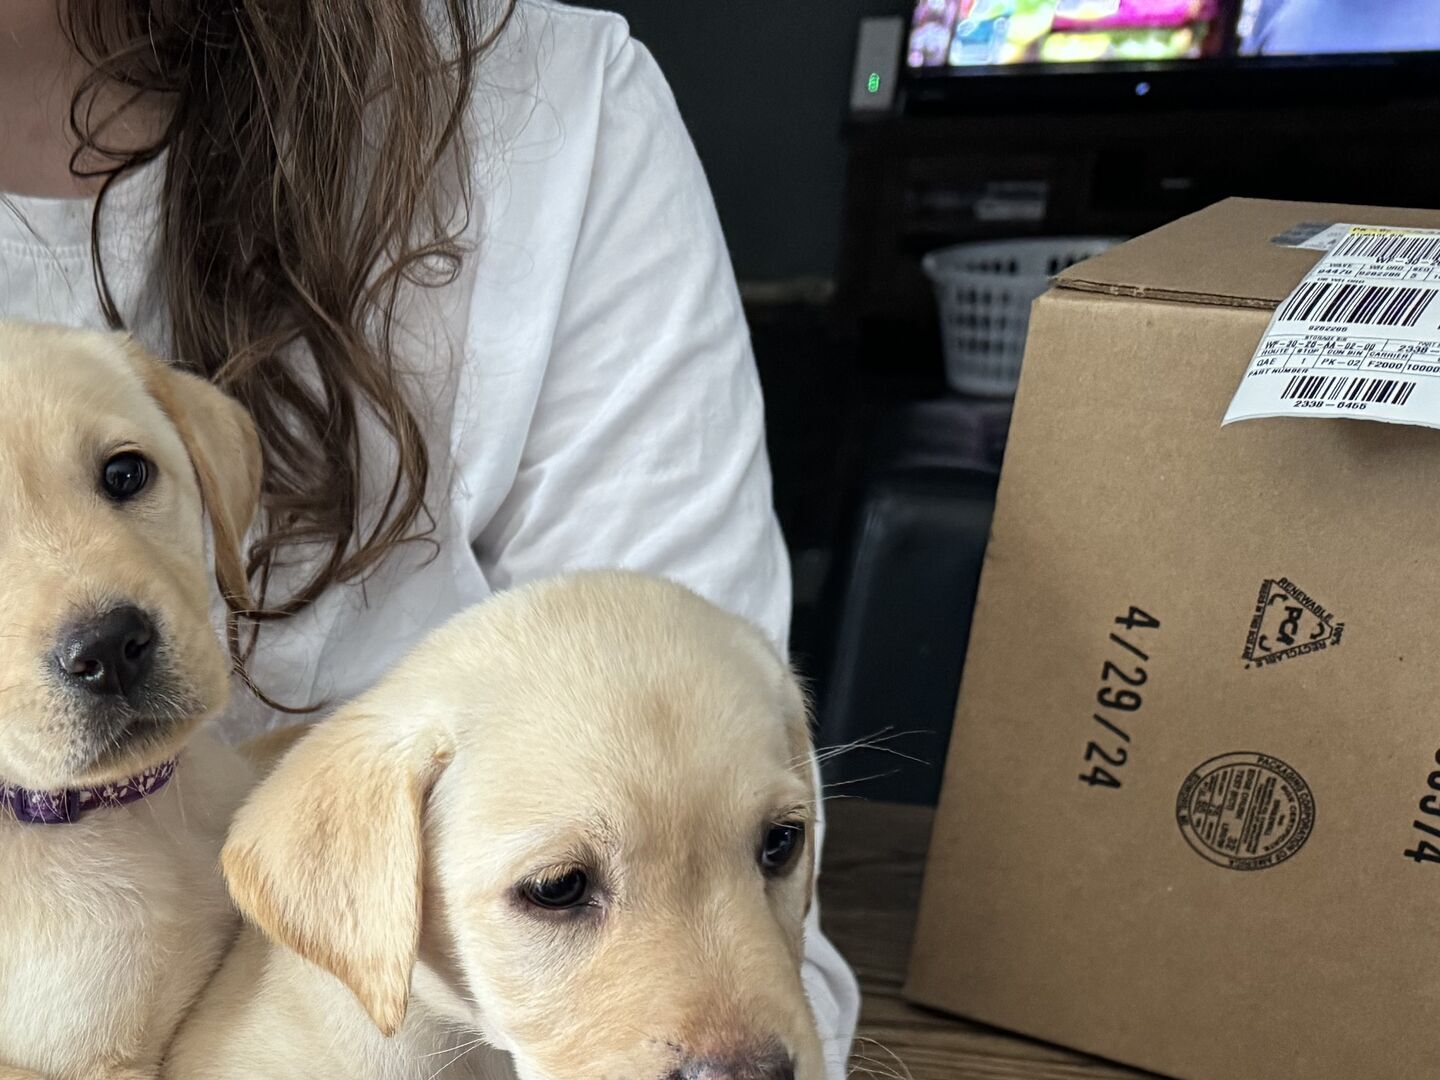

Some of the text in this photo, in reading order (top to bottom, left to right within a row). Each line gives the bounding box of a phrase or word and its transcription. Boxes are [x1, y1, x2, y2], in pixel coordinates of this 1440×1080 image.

[1247, 368, 1271, 378] PART
[1367, 360, 1403, 369] F2000
[1277, 577, 1334, 624] RENEWABLE
[1276, 606, 1303, 646] PCA
[1078, 605, 1161, 789] 4/29/24
